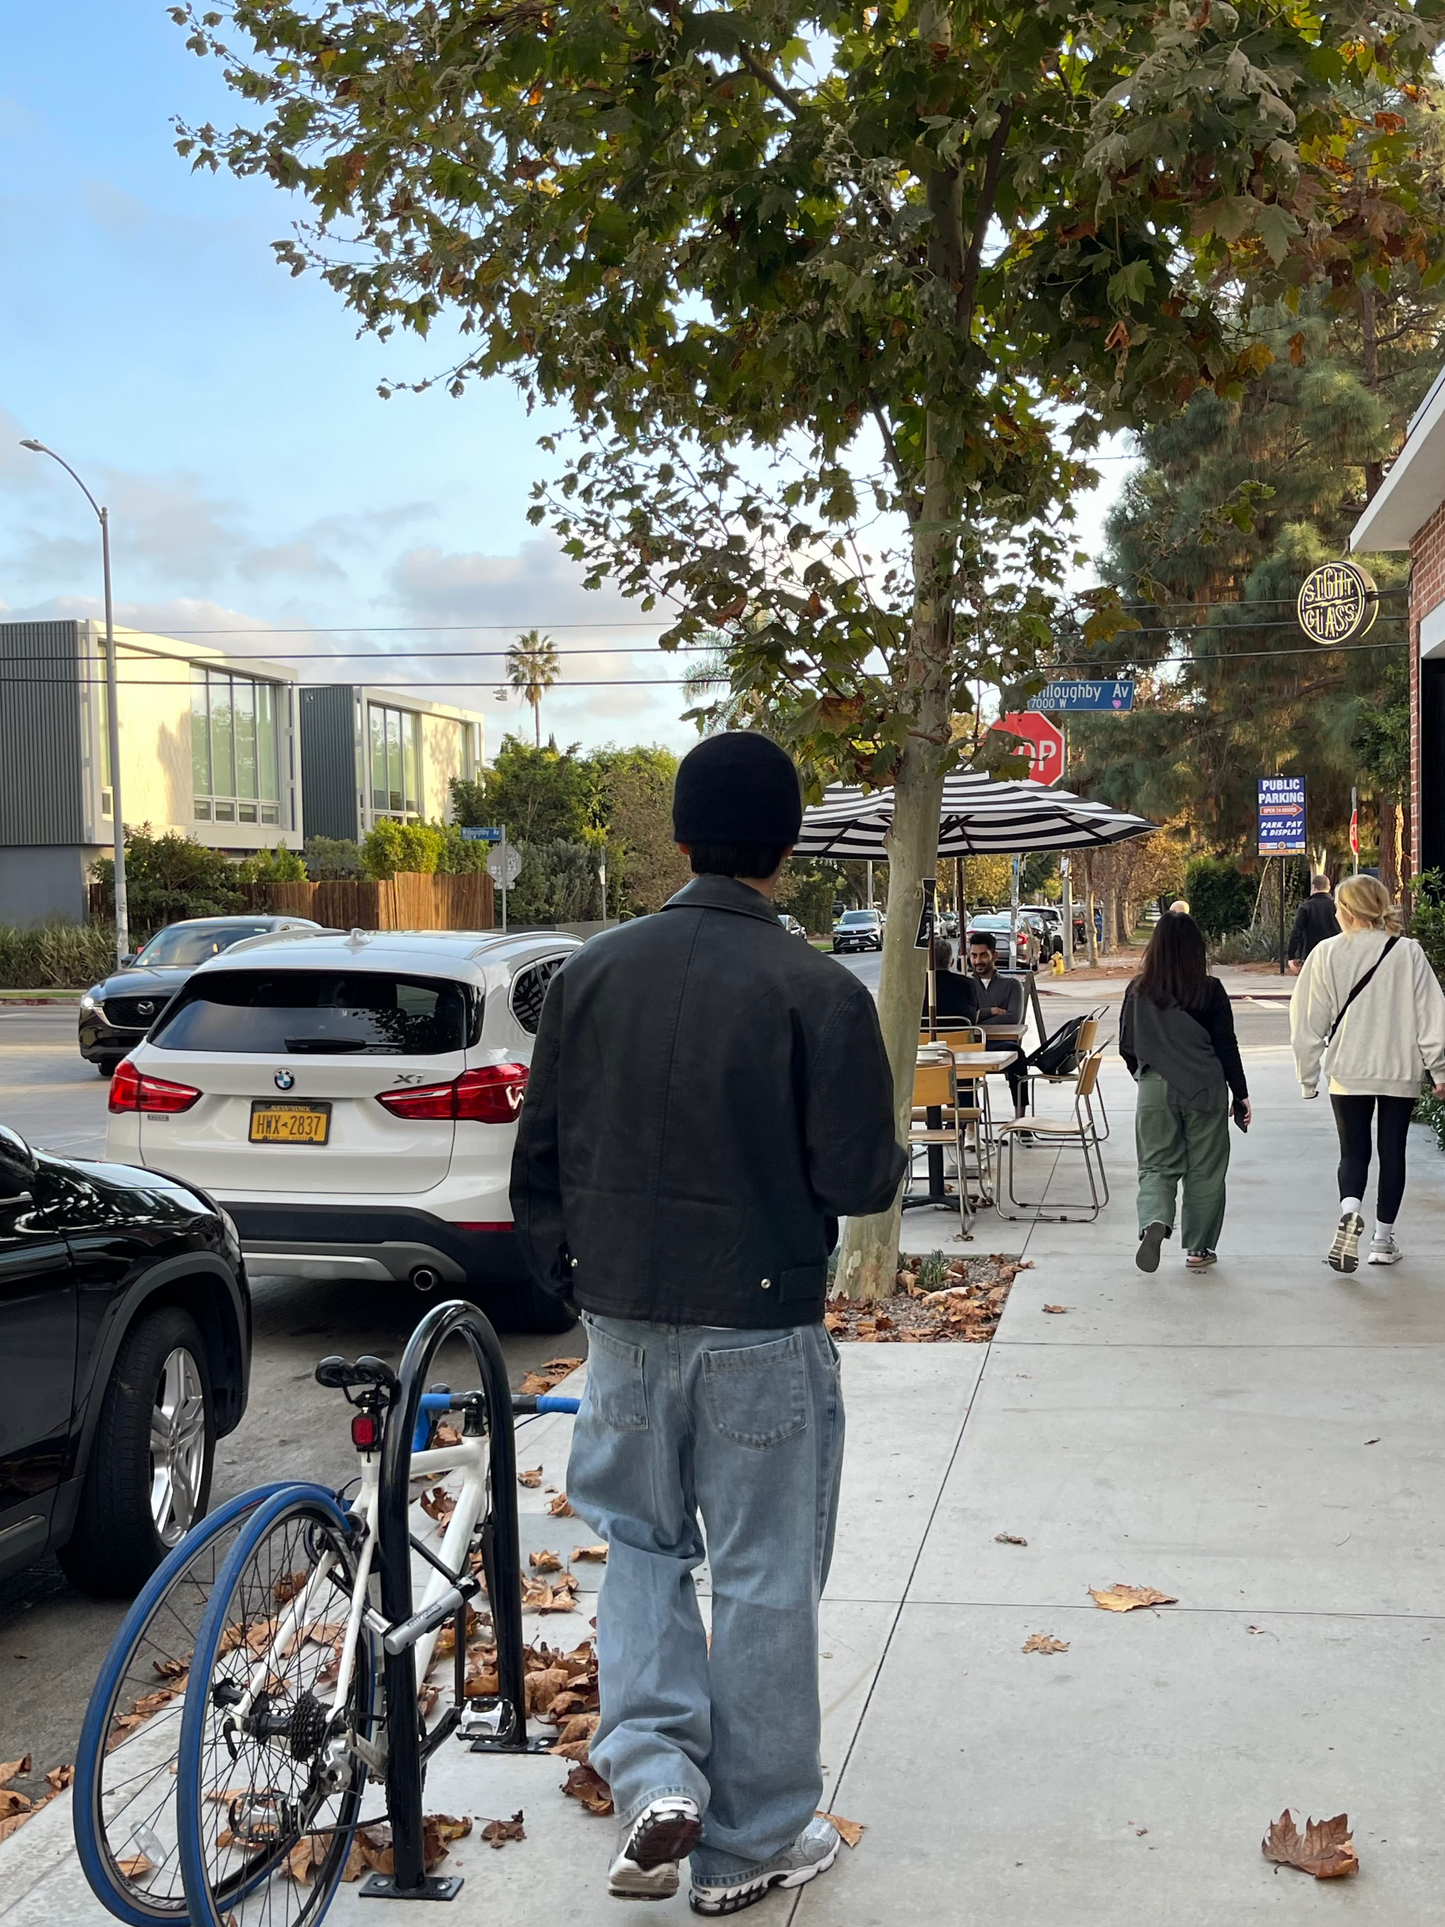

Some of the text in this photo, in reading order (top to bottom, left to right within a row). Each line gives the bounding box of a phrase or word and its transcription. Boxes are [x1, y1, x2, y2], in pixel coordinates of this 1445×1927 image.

[1305, 568, 1353, 602] SIGHT
[1306, 603, 1355, 638] GLASS
[1037, 683, 1129, 703] illoughby Av
[1031, 698, 1067, 709] 7000 W
[1262, 779, 1300, 791] PUBLIC
[1258, 792, 1304, 804] PARKING
[1261, 828, 1303, 837] & DISPLAY
[392, 1073, 425, 1084] X1
[289, 1115, 322, 1136] 2837
